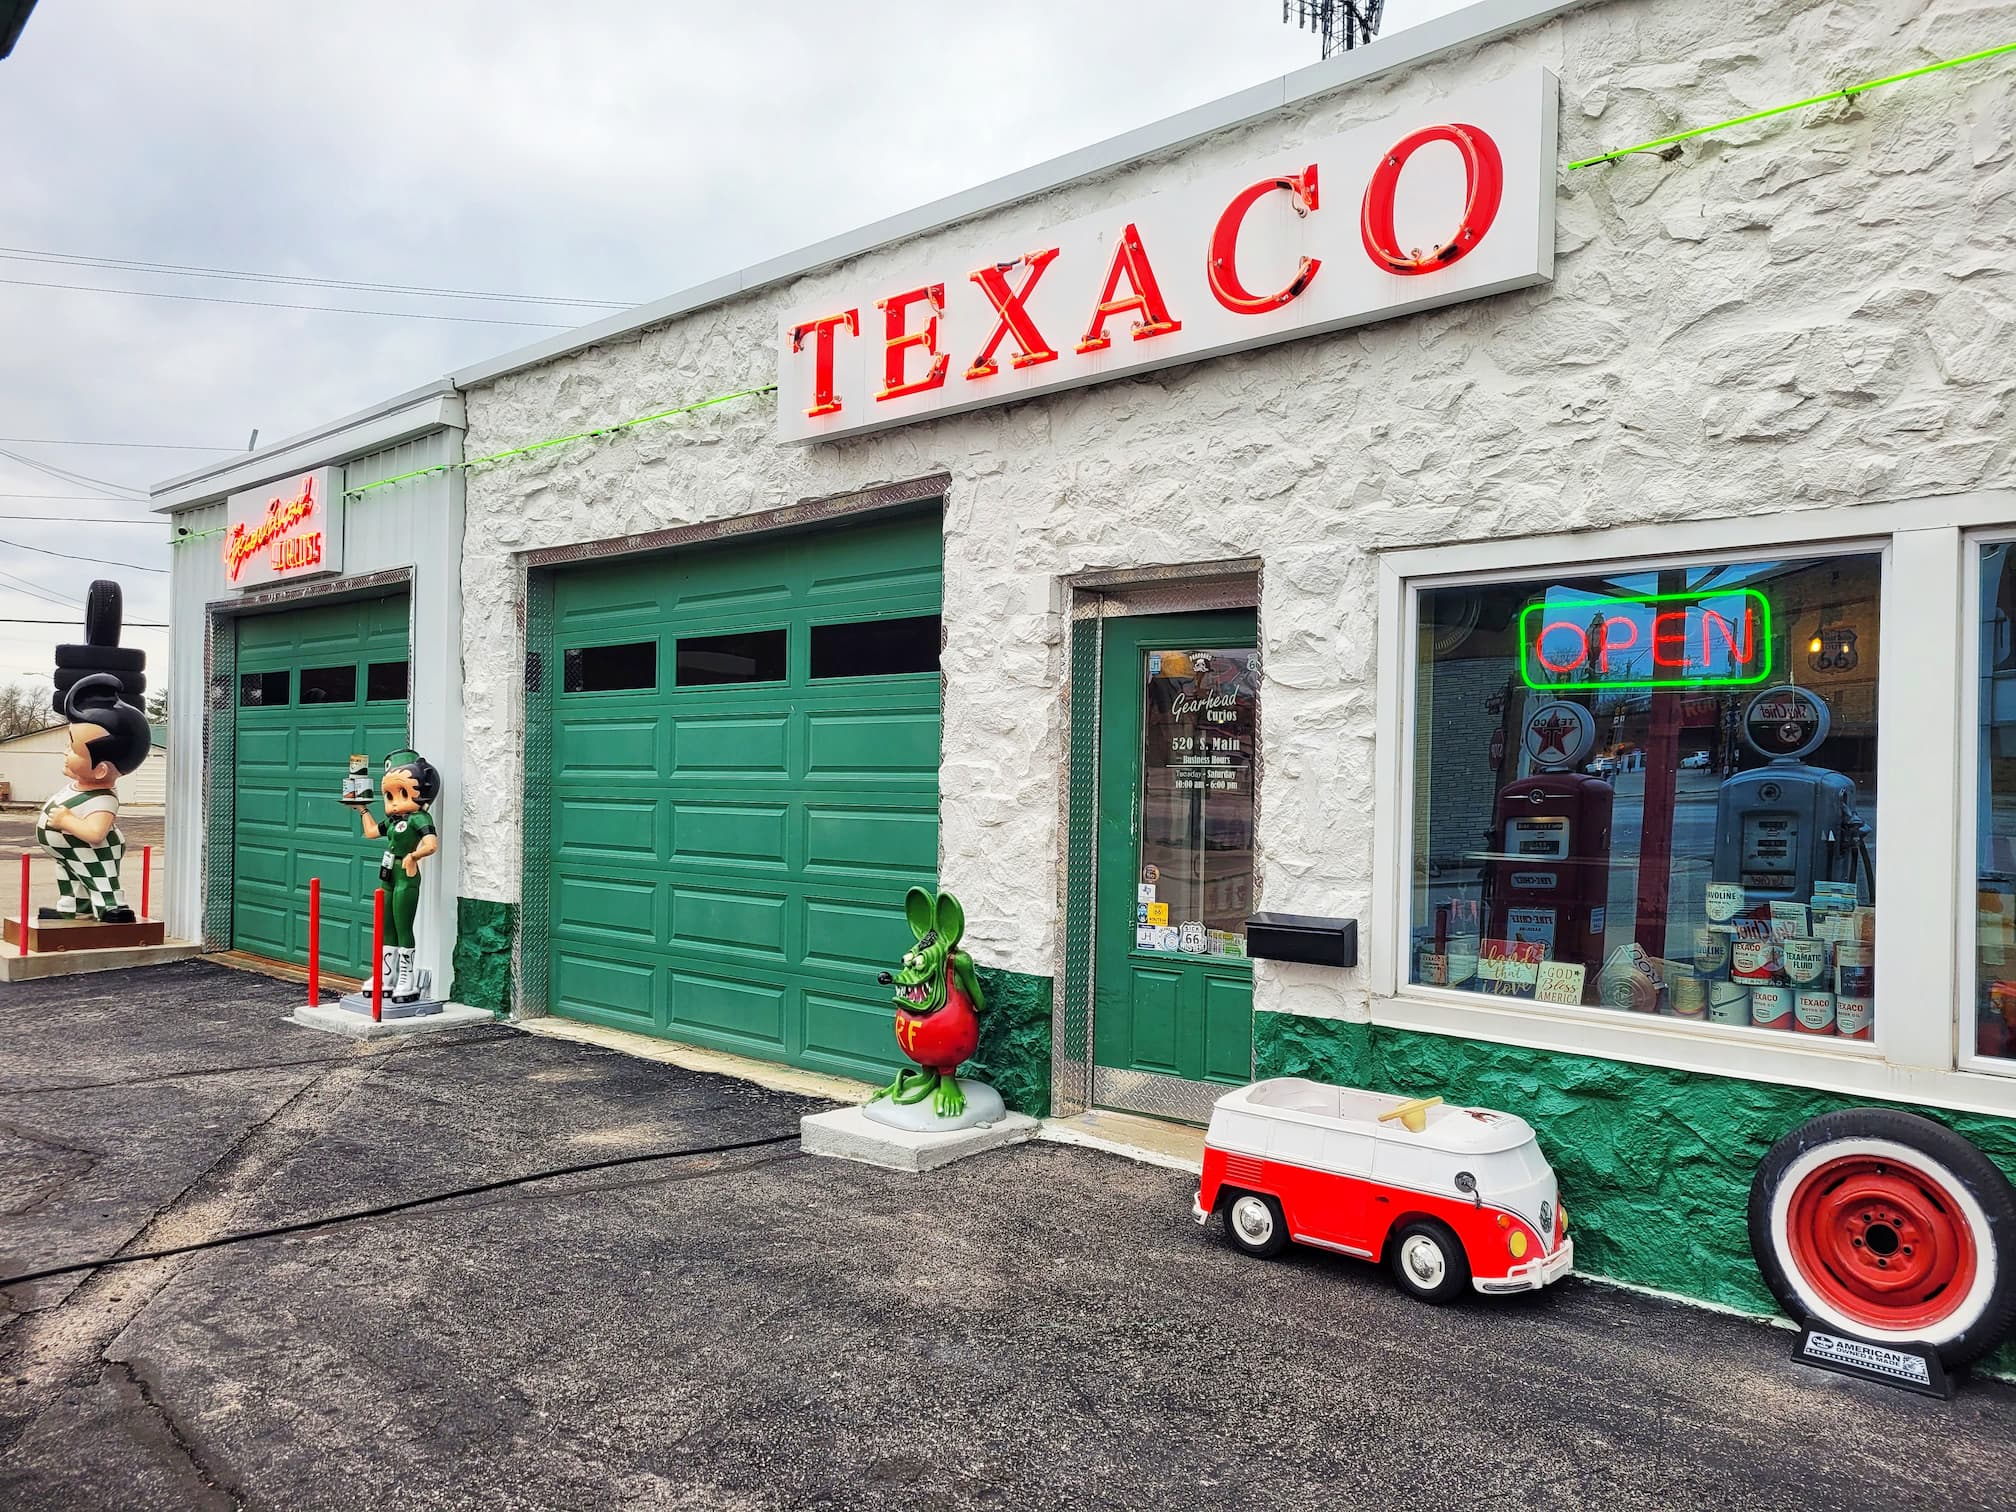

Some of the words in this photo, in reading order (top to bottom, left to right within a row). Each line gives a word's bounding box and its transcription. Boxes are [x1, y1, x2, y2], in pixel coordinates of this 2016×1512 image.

[787, 123, 1504, 417] TEXACO
[1537, 608, 1753, 673] OPEN
[1817, 651, 1850, 669] 66
[1172, 684, 1239, 722] Gearhead
[1207, 710, 1237, 722] Curios
[1172, 737, 1193, 751] 520
[1200, 737, 1209, 751] S.
[1212, 737, 1240, 751] Main
[1183, 755, 1210, 764] Business
[1211, 755, 1231, 764] Hours
[1176, 770, 1201, 780] Tuesday
[1207, 770, 1236, 779] Saturday
[1176, 780, 1193, 789] 10:00
[1194, 781, 1205, 789] am
[1210, 780, 1226, 789] 6:00
[1226, 781, 1238, 790] pm
[1185, 934, 1200, 945] 66
[1787, 951, 1822, 963] TEXAMATIC
[1793, 961, 1813, 970] FLUID
[1494, 966, 1522, 979] that
[1547, 967, 1573, 979] GOD
[1493, 978, 1532, 995] love
[1542, 977, 1577, 993] Bless
[1537, 991, 1578, 1004] AMERICA
[1800, 998, 1830, 1007] TEXACO
[895, 1015, 923, 1052] RF
[1836, 1342, 1900, 1362] AMERICAN
[1836, 1348, 1867, 1359] OWNED
[1875, 1357, 1900, 1367] MADE
